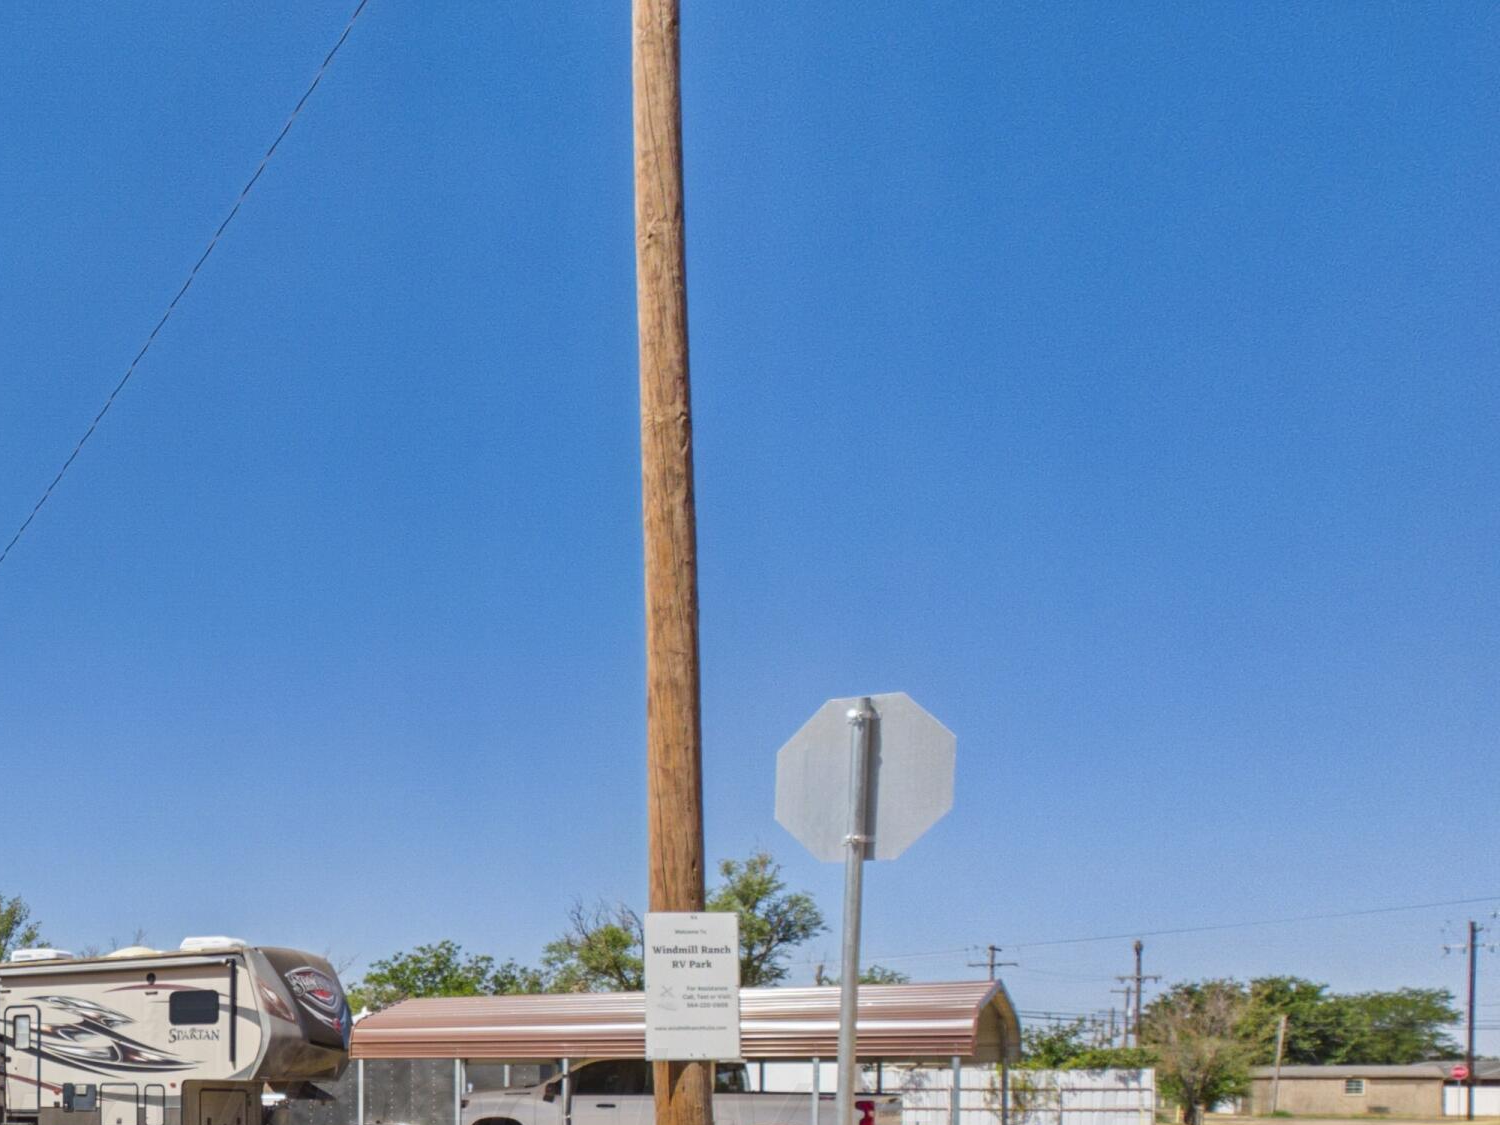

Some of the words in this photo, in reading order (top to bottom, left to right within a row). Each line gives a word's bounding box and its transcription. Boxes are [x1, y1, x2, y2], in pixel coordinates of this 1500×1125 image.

[652, 945, 698, 954] Windmill
[701, 945, 731, 954] Ranch
[672, 960, 686, 969] RV
[689, 960, 712, 969] Park
[168, 1027, 220, 1044] SPARTAN
